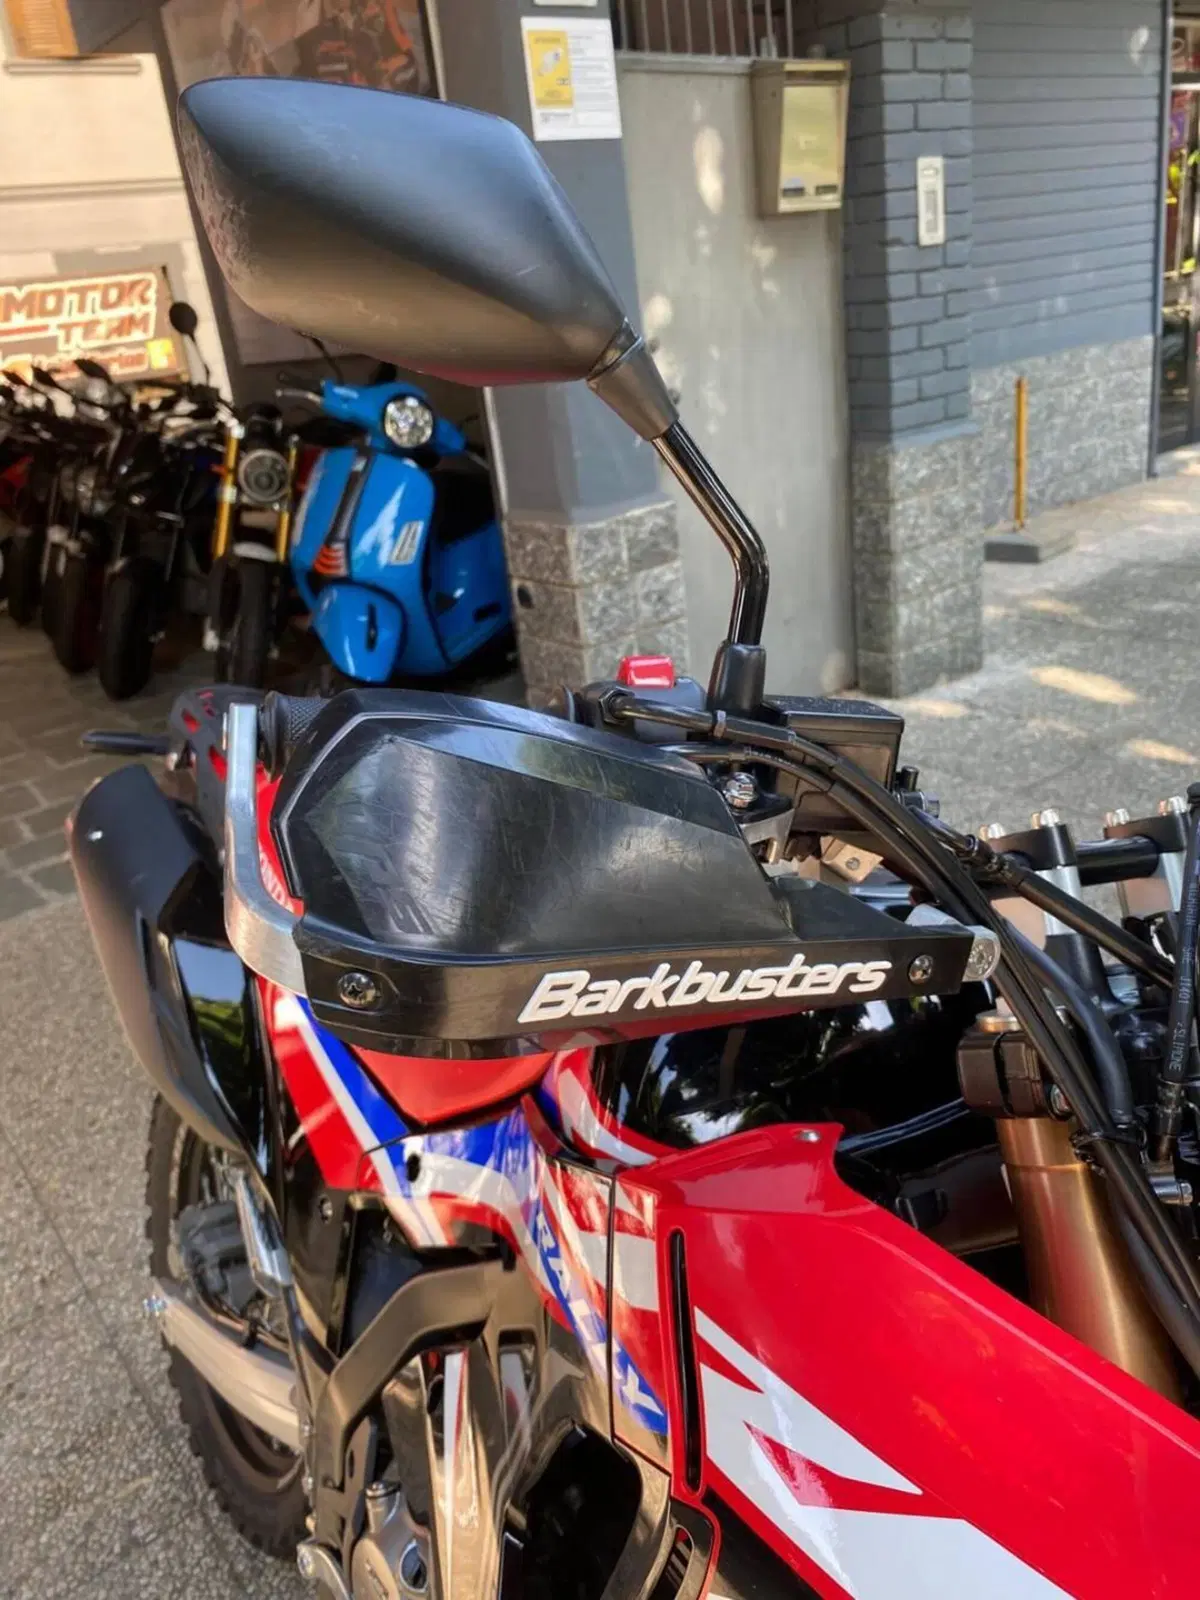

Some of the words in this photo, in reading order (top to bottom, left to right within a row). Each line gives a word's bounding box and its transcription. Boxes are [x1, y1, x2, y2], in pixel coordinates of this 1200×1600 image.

[518, 953, 892, 1023] Barkbusters
[1179, 976, 1193, 1004] J1401
[535, 1208, 665, 1417] RALLY
